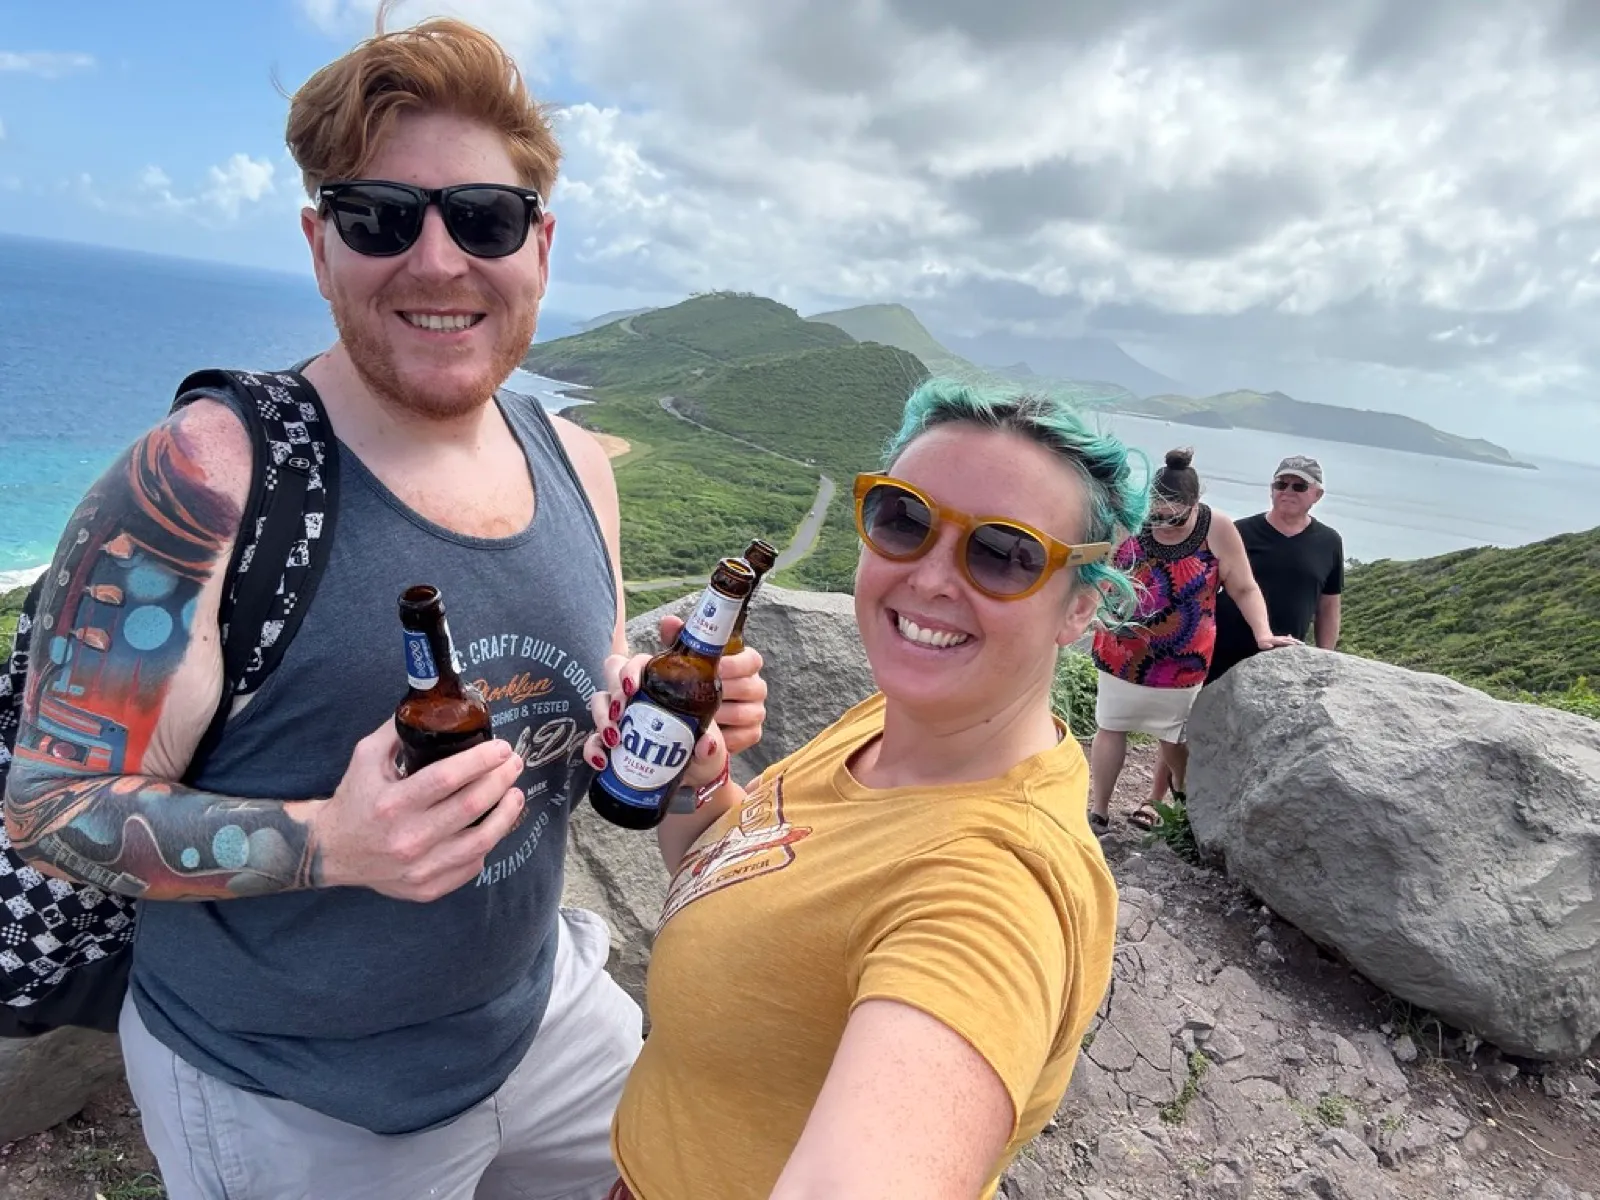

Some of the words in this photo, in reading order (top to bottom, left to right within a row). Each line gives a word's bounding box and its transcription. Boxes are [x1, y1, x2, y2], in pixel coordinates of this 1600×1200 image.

[469, 634, 519, 664] CRAFT
[521, 636, 567, 669] BUILT
[521, 704, 529, 718] &
[532, 701, 570, 715] TESTED
[623, 755, 656, 775] PILSNER
[476, 811, 549, 887] GREENVIEW
